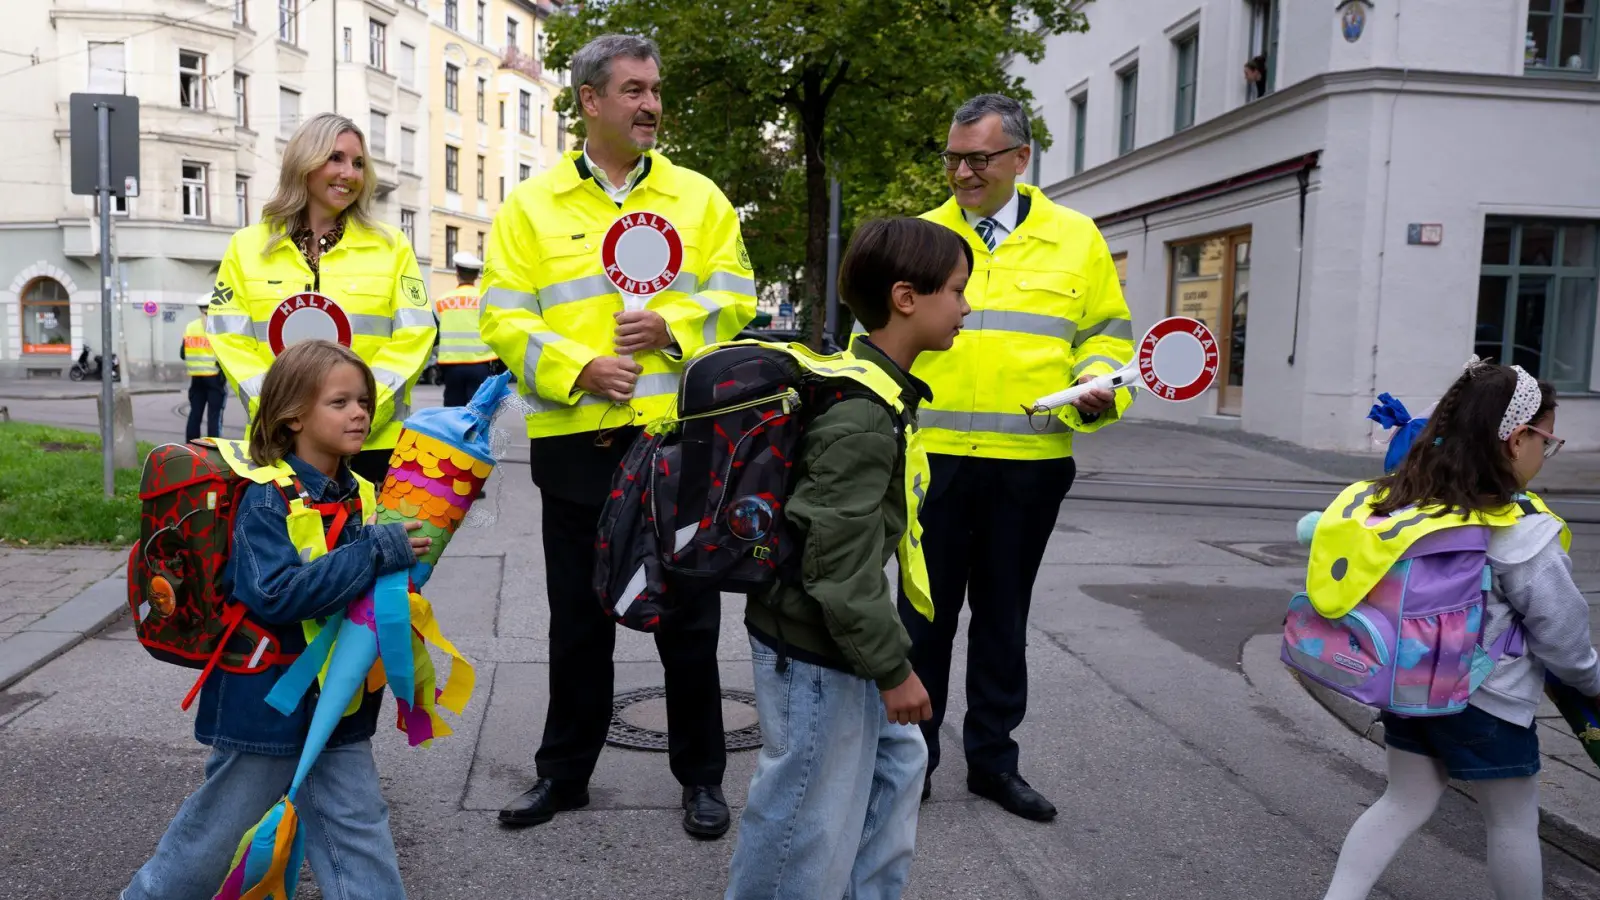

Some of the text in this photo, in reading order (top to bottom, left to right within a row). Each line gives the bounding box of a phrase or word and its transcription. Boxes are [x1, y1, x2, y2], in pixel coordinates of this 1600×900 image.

[621, 213, 673, 234] HALT
[606, 263, 675, 294] KINDER
[279, 295, 333, 316] HALT
[1192, 324, 1217, 375] HALT
[1140, 333, 1177, 399] KINDER
